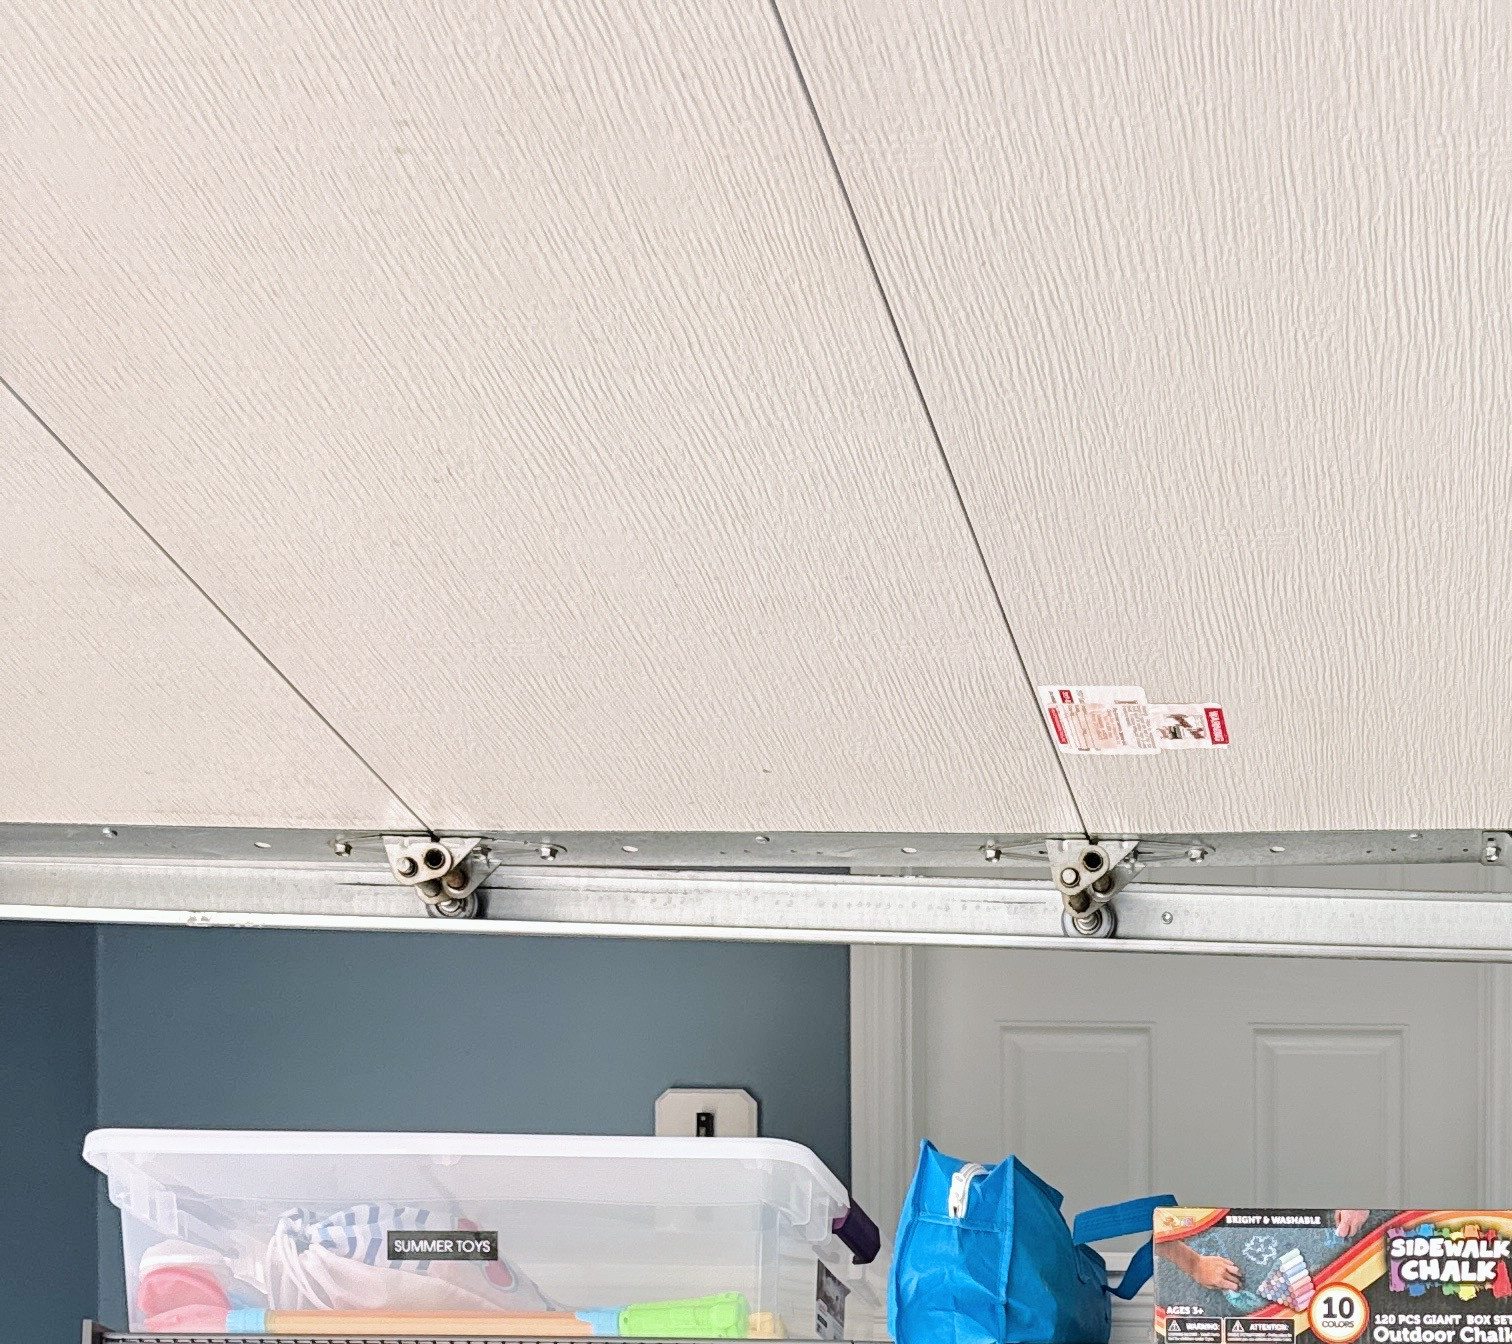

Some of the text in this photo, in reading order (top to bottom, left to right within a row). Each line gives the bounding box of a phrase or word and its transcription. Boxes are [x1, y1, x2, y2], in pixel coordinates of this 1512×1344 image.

[1226, 1215, 1262, 1224] BRIGHT
[1271, 1215, 1321, 1224] WASHABLE
[394, 1239, 491, 1253] SUMMER TOYS
[1390, 1237, 1511, 1258] SIDEWALK
[1401, 1259, 1497, 1282] CHALK
[1322, 1296, 1355, 1319] 10
[1321, 1320, 1355, 1328] COLORS
[1374, 1314, 1396, 1325] 120
[1398, 1314, 1421, 1325] PCS
[1422, 1314, 1462, 1325] GIANT
[1466, 1314, 1492, 1325] BOX
[1373, 1325, 1456, 1343] Outdoor
